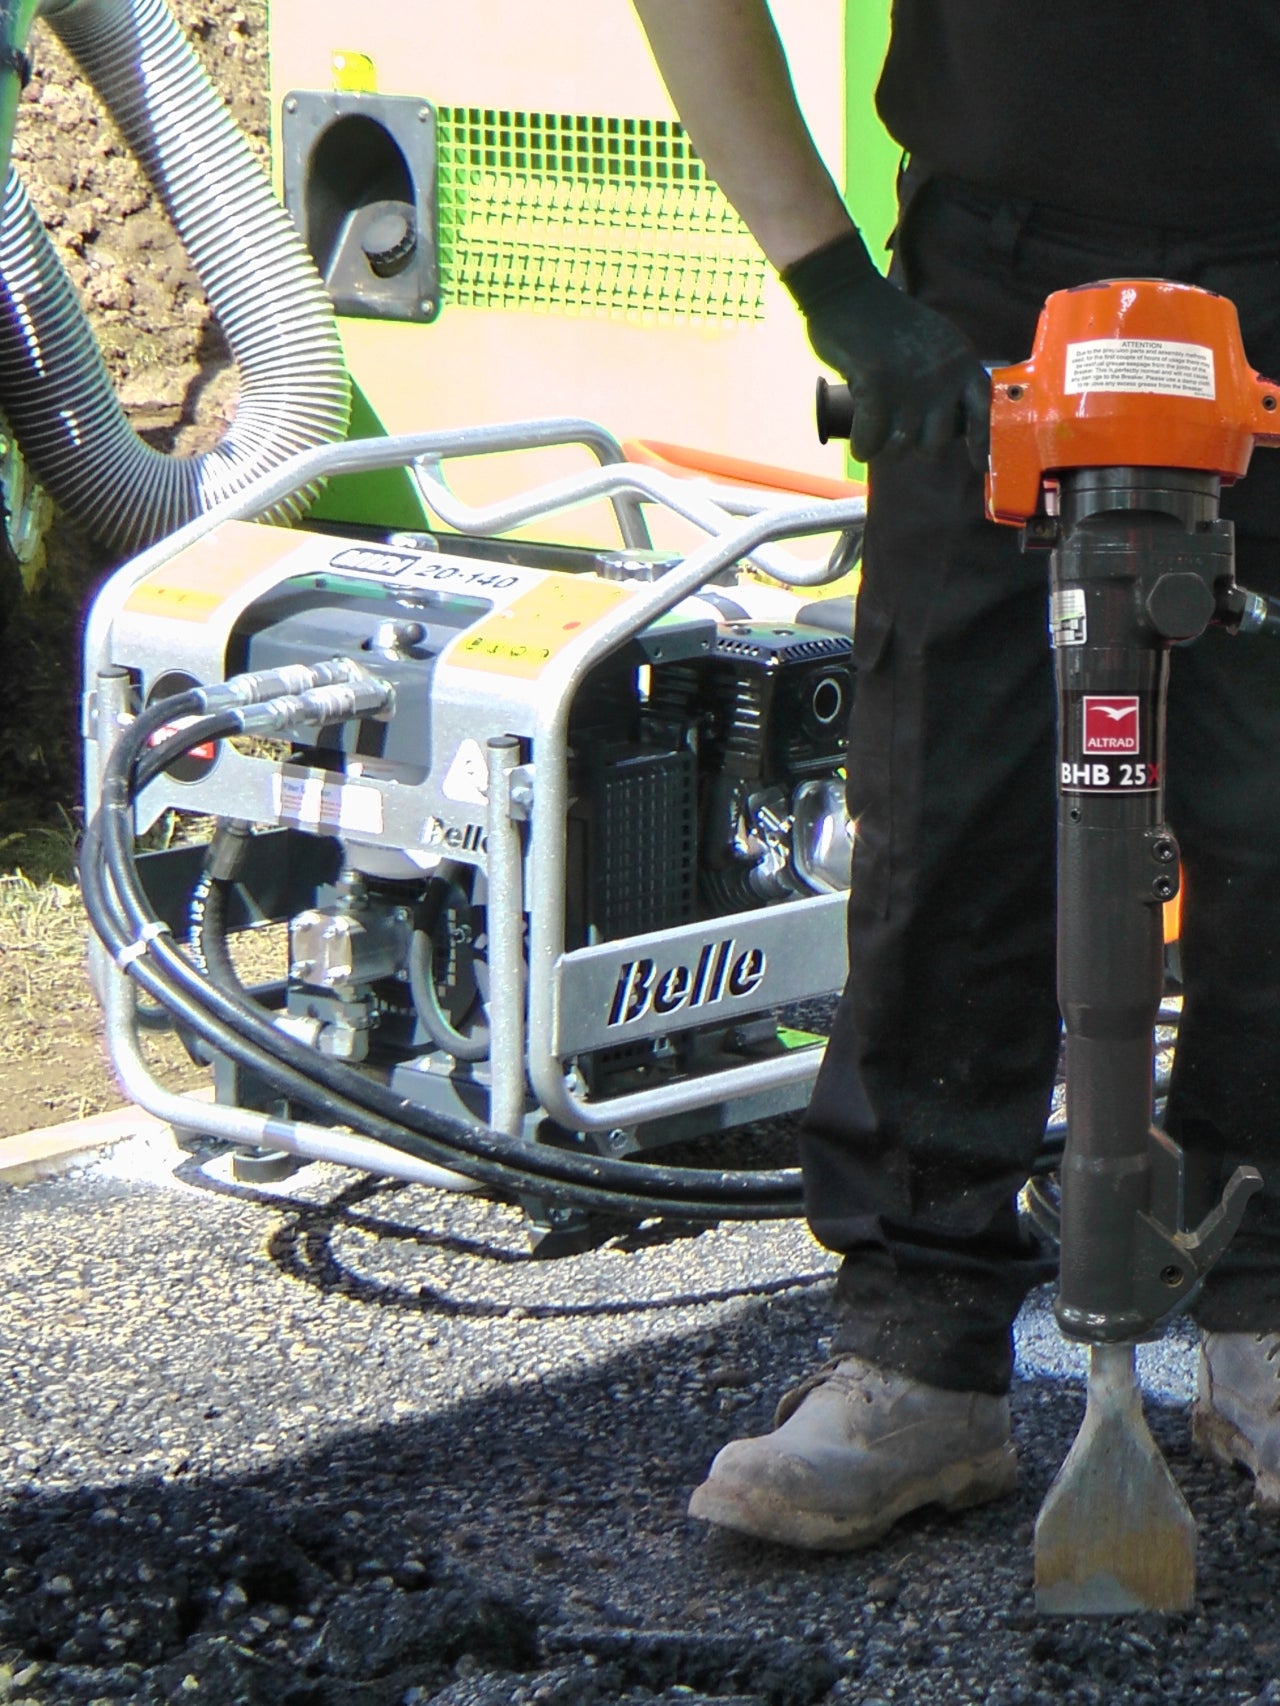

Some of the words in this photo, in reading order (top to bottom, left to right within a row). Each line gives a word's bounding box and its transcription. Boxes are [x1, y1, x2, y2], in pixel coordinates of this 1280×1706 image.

[1122, 341, 1163, 349] ATTENTION
[1087, 737, 1135, 748] ALTRAD
[1061, 763, 1110, 785] BHB
[607, 939, 767, 1028] Belle
